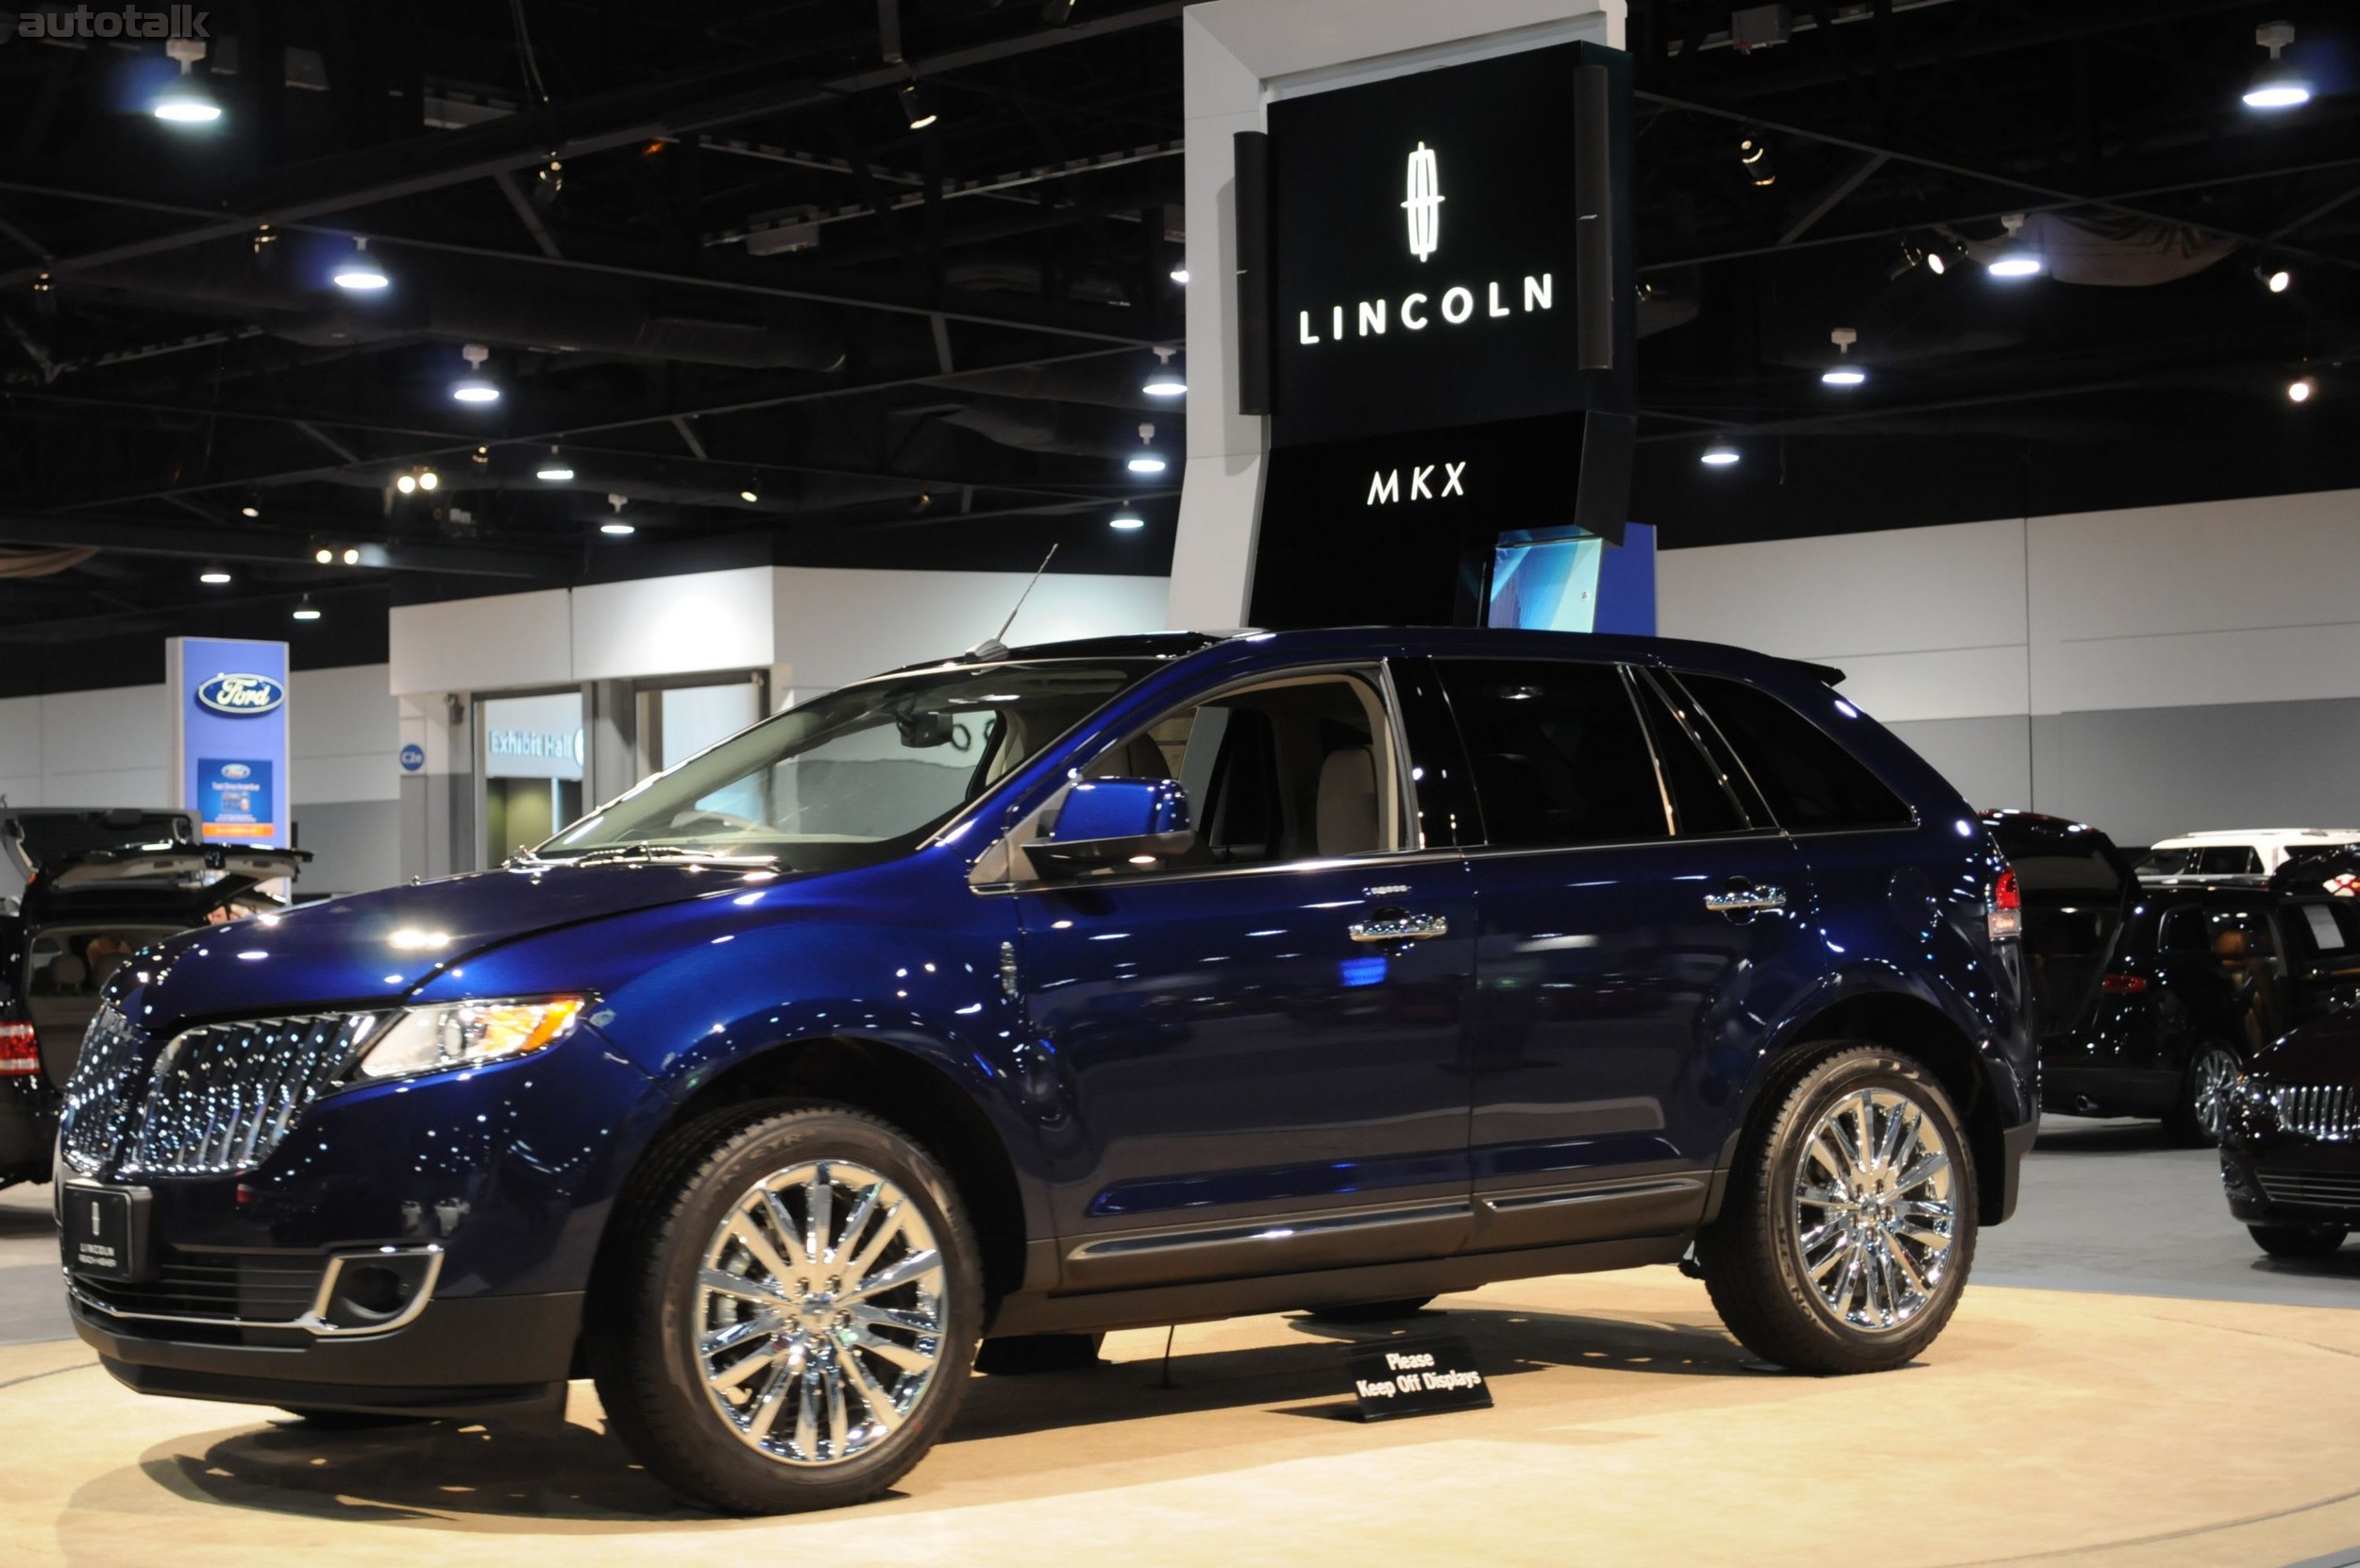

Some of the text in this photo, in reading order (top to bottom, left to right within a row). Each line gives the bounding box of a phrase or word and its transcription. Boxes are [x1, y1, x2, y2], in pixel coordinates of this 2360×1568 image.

[1299, 272, 1553, 346] LINCOLN
[1366, 460, 1467, 506] MKX
[216, 678, 272, 706] Ford
[489, 730, 573, 759] Exhibit Hall
[1385, 1353, 1435, 1371] Please
[1356, 1369, 1482, 1398] Keep Off Displays
